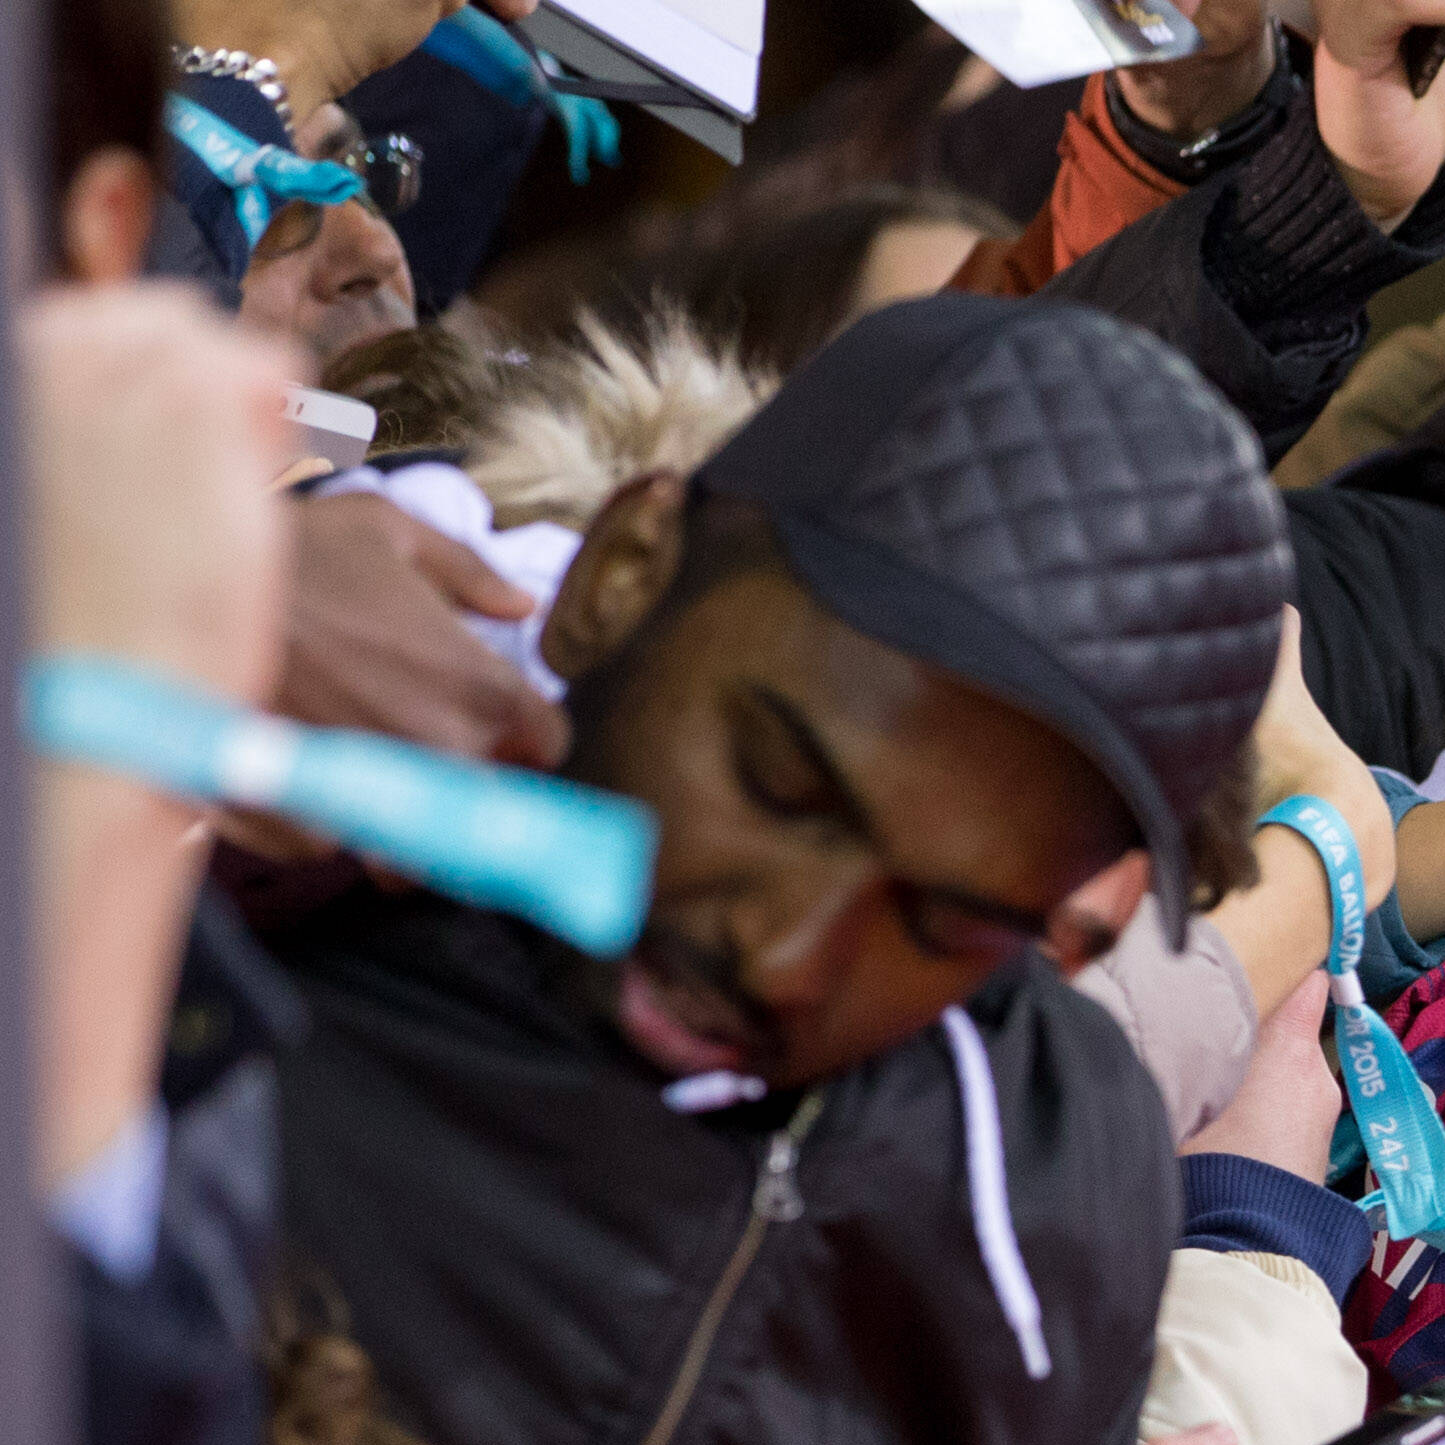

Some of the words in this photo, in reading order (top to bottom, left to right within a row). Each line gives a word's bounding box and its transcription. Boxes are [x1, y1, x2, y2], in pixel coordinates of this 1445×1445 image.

[1297, 807, 1348, 868] FIFA
[1349, 1040, 1386, 1098] 2015
[1368, 1116, 1410, 1172] 247
